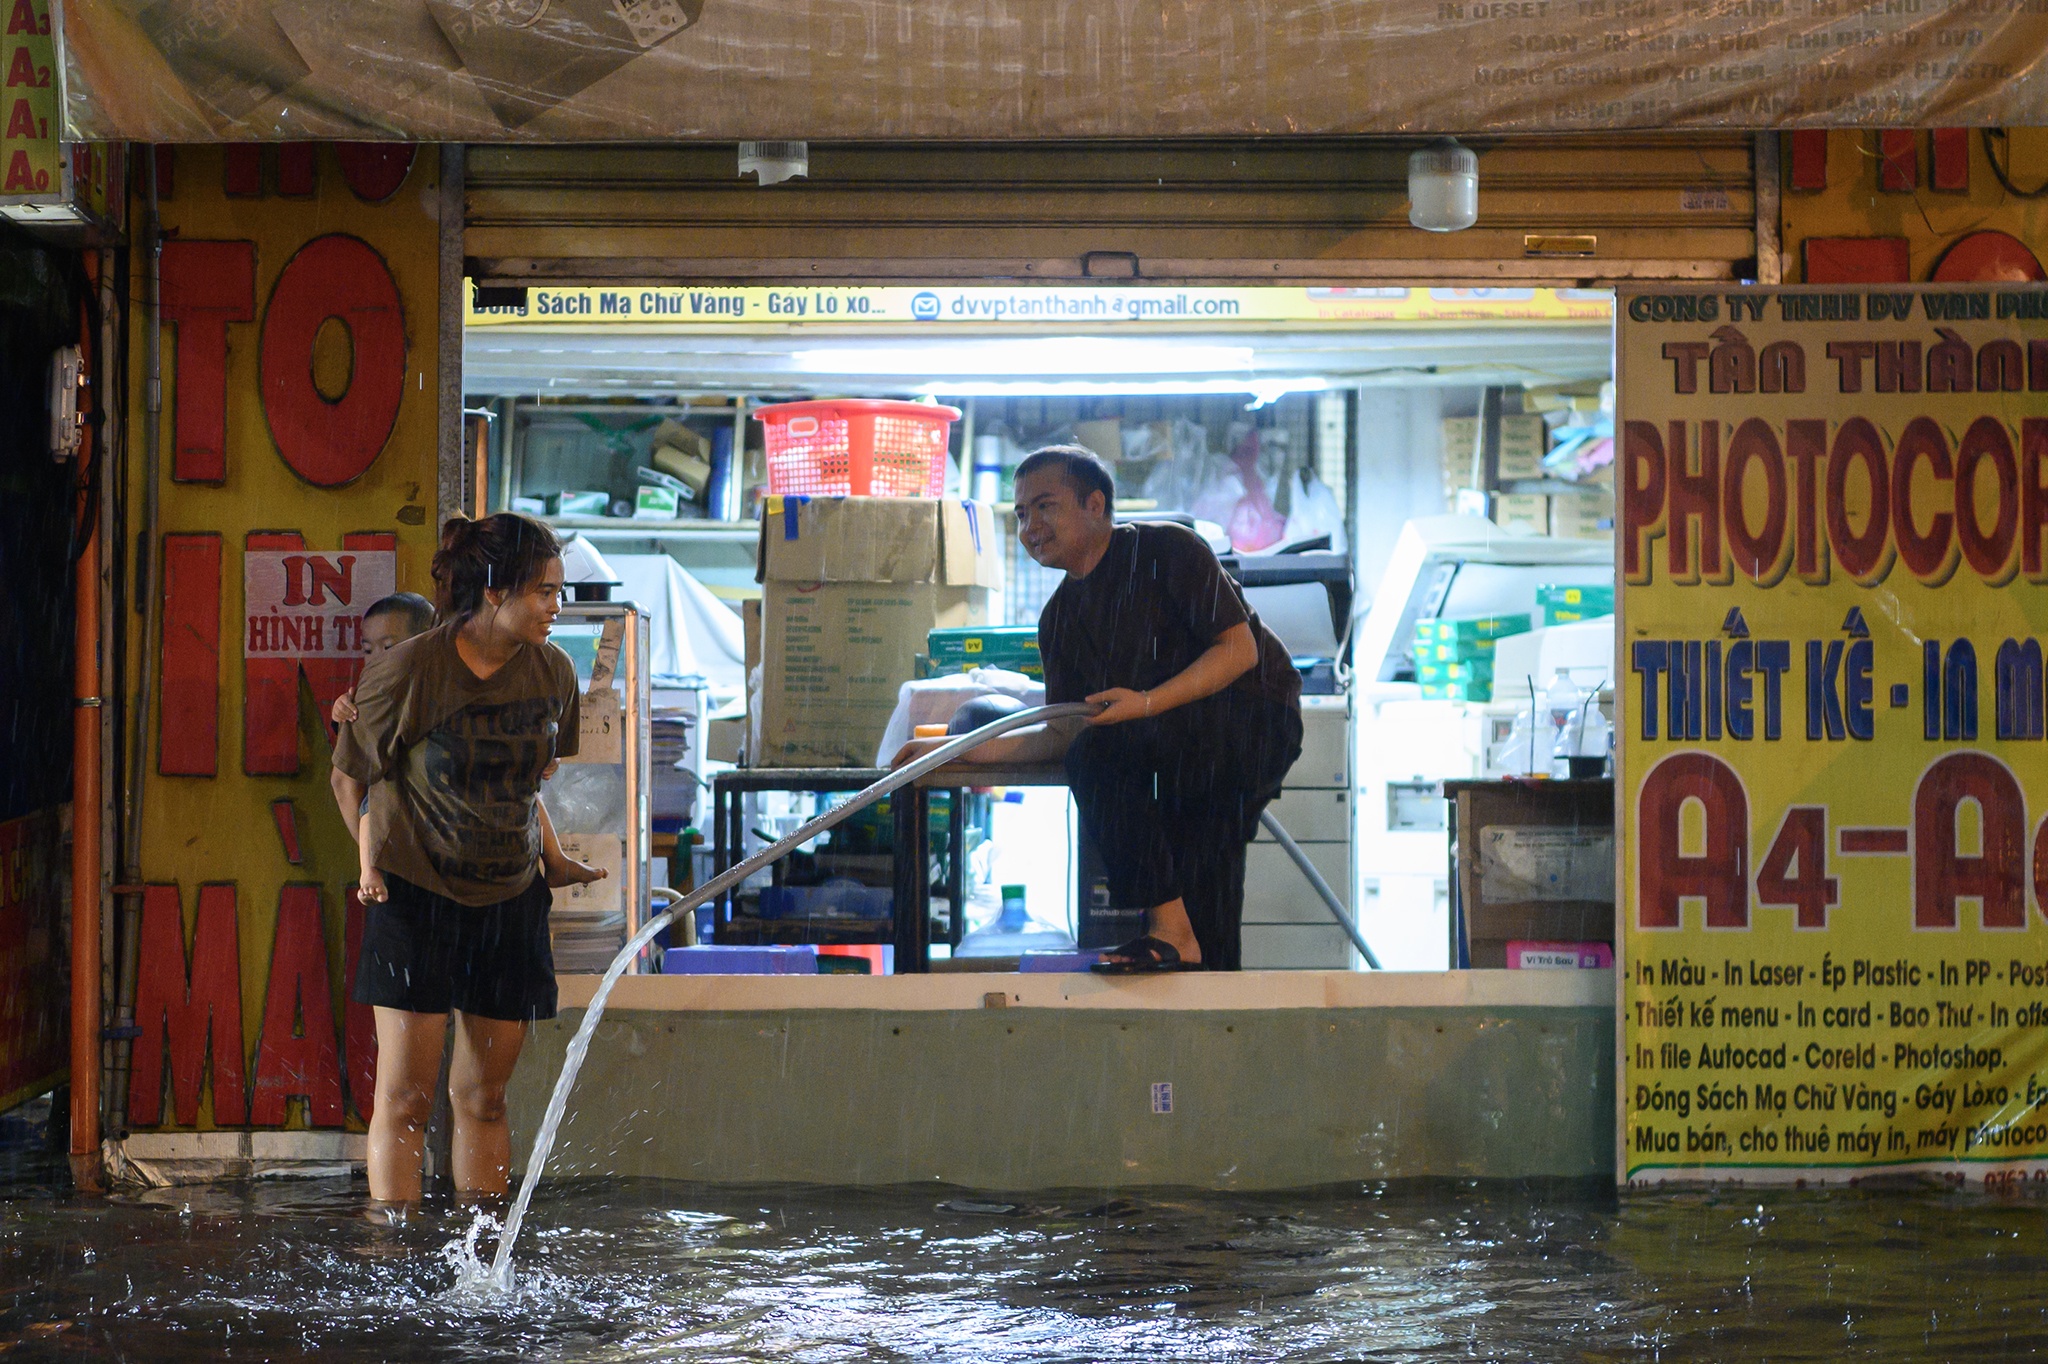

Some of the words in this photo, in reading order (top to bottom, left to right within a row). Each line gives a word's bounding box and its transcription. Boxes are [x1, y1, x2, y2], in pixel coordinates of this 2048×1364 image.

[1508, 34, 1579, 52] SCAN
[6, 47, 51, 88] A2
[6, 98, 48, 139] A1
[4, 149, 50, 191] A0
[537, 292, 592, 316] Sách
[599, 292, 632, 319] Mạ
[639, 292, 685, 316] Chữ
[689, 292, 745, 318] Vàng
[767, 291, 808, 318] Gáy
[815, 291, 839, 315] Lò
[1725, 293, 1770, 322] TY
[1777, 293, 1860, 321] TNHH
[1866, 293, 1915, 321] DV
[154, 233, 409, 489] TO
[1662, 324, 1807, 394] TÂN
[281, 554, 357, 608] IN
[247, 606, 325, 653] HÌNH
[1631, 605, 1791, 742] THIẾT
[1805, 605, 1875, 742] KẾ
[1922, 636, 1980, 742] IN
[1636, 958, 1655, 987] In
[1661, 956, 1706, 987] Màu
[1724, 958, 1743, 987] In
[1750, 958, 1805, 987] Laser
[1822, 952, 1847, 992] Ép
[1853, 958, 1922, 987] Plastic
[1940, 958, 1959, 987] In
[1966, 958, 1992, 987] PP
[1635, 995, 1684, 1028] Thiết
[1690, 995, 1717, 1028] kế
[1721, 1006, 1779, 1028] menu
[1797, 1000, 1817, 1028] In
[1823, 1000, 1872, 1028] card
[1890, 1000, 1931, 1028] Bao
[1936, 1000, 1974, 1028] Thư
[1990, 1000, 2010, 1028] In
[1636, 1042, 1655, 1069] In
[1660, 1042, 1692, 1069] file
[1697, 1042, 1787, 1070] Autocad
[1804, 1042, 1876, 1070] Coreld
[1894, 1042, 2008, 1074] Photoshop.
[1636, 1081, 1691, 1119] Đóng
[1696, 1080, 1748, 1111] Sách
[1755, 1083, 1788, 1119] Mạ
[1793, 1083, 1838, 1112] Chữ
[1842, 1081, 1897, 1119] Vàng
[1915, 1080, 1958, 1115] Gáy
[1963, 1080, 2010, 1109] Lòxo
[1635, 1126, 1680, 1153] Mua
[1686, 1122, 1733, 1158] bán,
[1739, 1125, 1778, 1153] cho
[1785, 1122, 1831, 1153] thuê
[1836, 1122, 1882, 1158] máy
[1887, 1124, 1912, 1156] in,
[1917, 1120, 1960, 1152] máy
